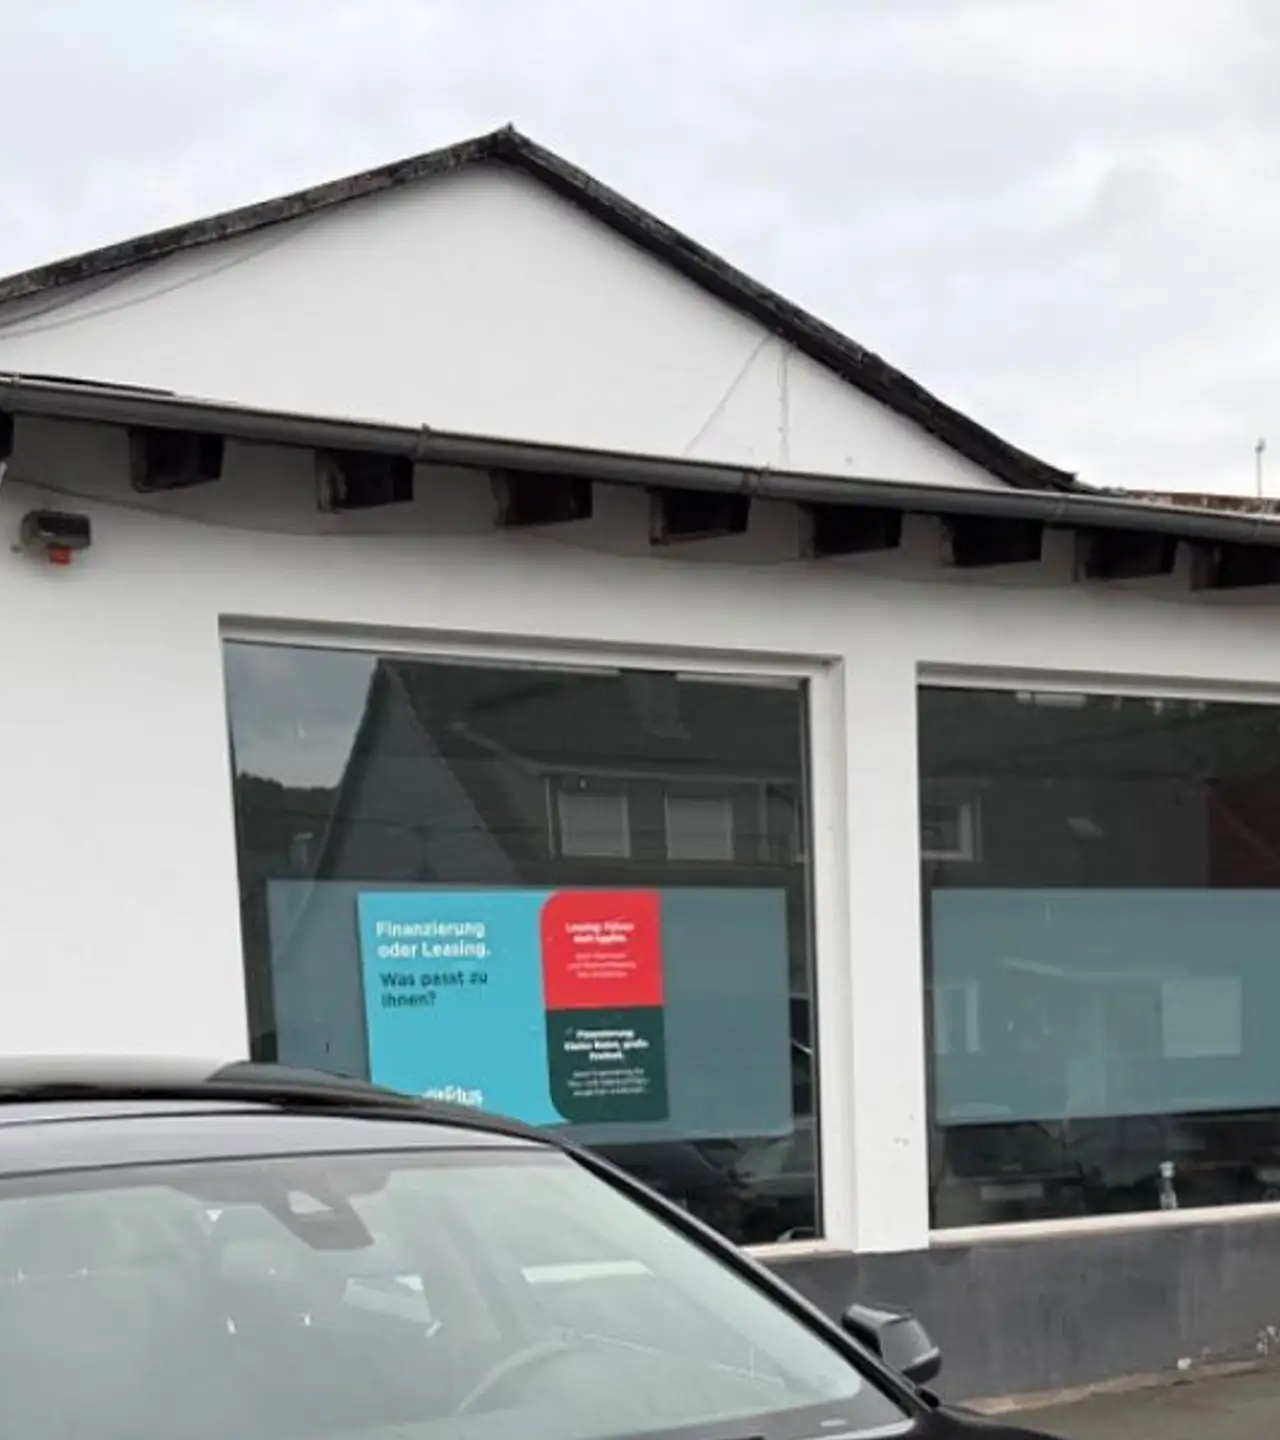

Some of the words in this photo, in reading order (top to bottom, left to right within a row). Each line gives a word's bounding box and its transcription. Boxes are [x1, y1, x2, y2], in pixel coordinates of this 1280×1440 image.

[376, 920, 486, 939] Finanzierung
[378, 940, 417, 958] oder
[421, 939, 492, 959] Leasing.
[380, 972, 416, 987] Was
[421, 970, 465, 988] passt
[470, 972, 488, 986] zu
[381, 990, 437, 1008] Ihnen?
